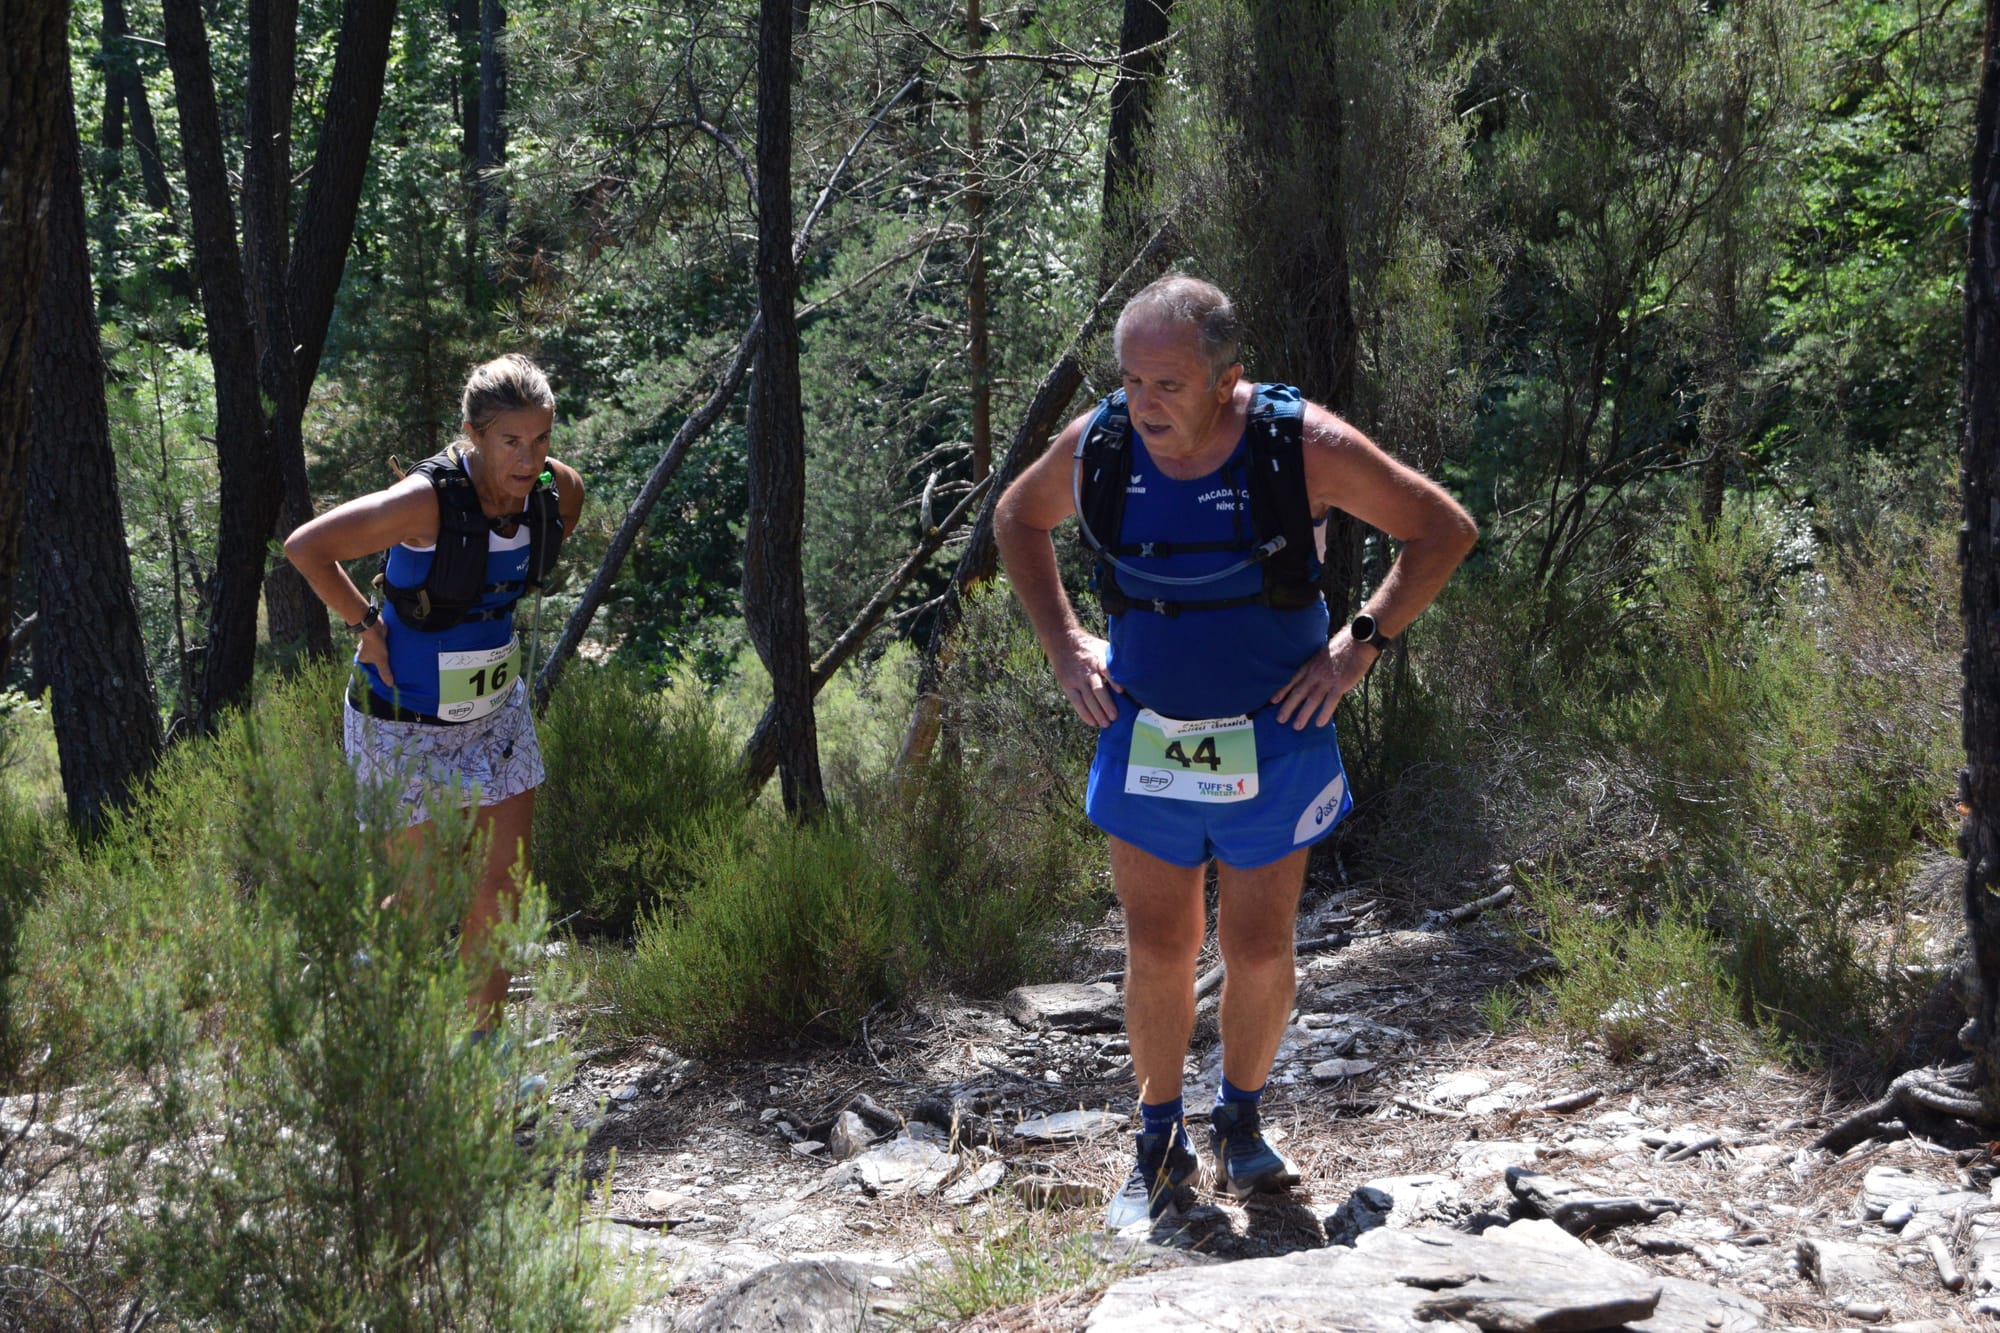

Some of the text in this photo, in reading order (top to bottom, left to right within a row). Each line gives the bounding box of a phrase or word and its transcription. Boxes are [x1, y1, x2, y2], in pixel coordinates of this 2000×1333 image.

[1216, 500, 1244, 511] NÎMOS
[469, 662, 508, 697] 16
[1165, 736, 1221, 771] 44
[1139, 775, 1169, 786] BFP
[1197, 781, 1233, 791] TUFF'S
